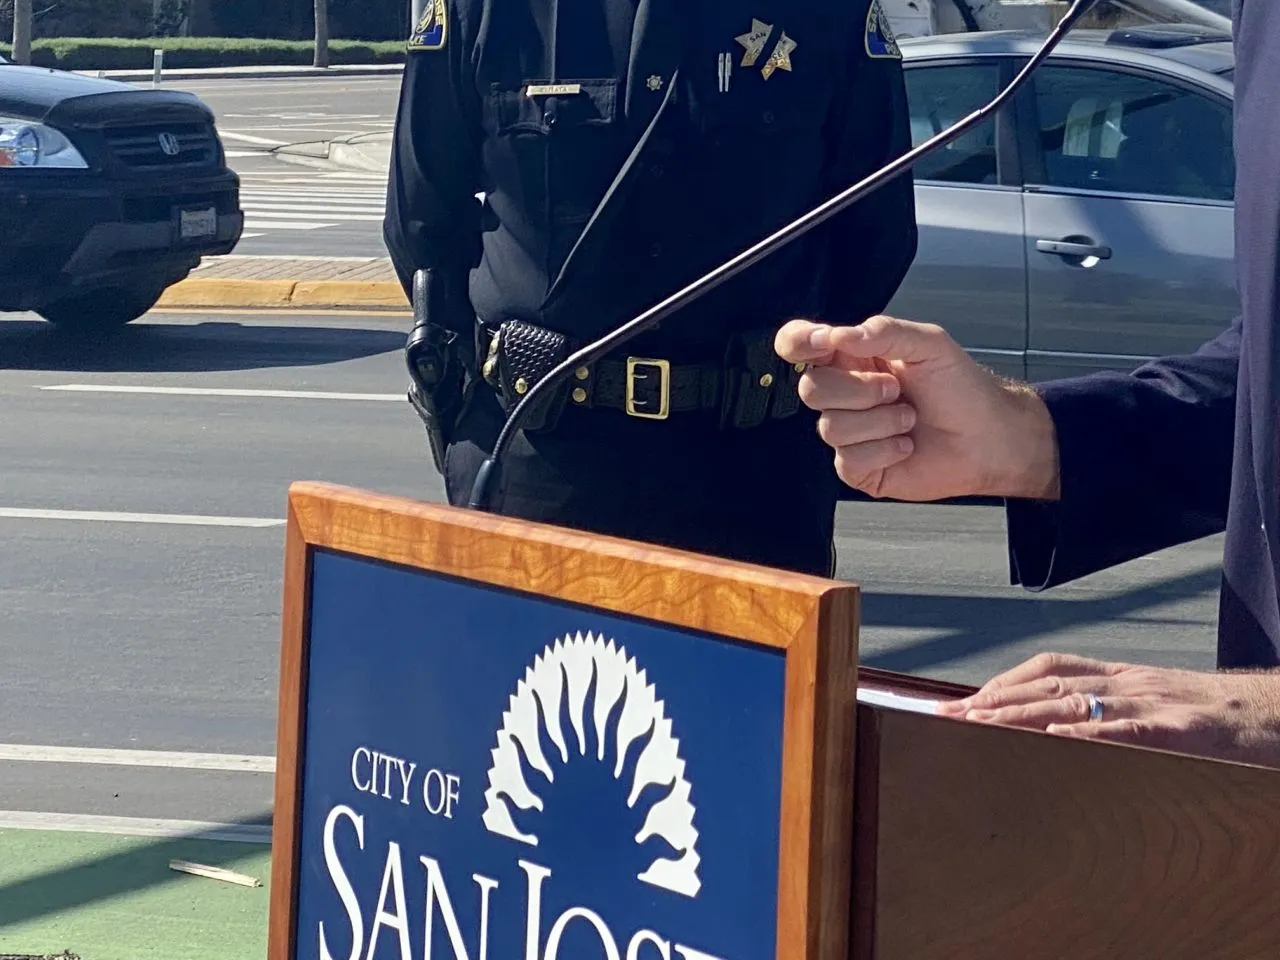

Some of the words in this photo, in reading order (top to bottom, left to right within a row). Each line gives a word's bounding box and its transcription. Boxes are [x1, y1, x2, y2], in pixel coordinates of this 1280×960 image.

[351, 747, 417, 805] CITY
[423, 769, 460, 818] OF
[319, 804, 499, 960] SAN
